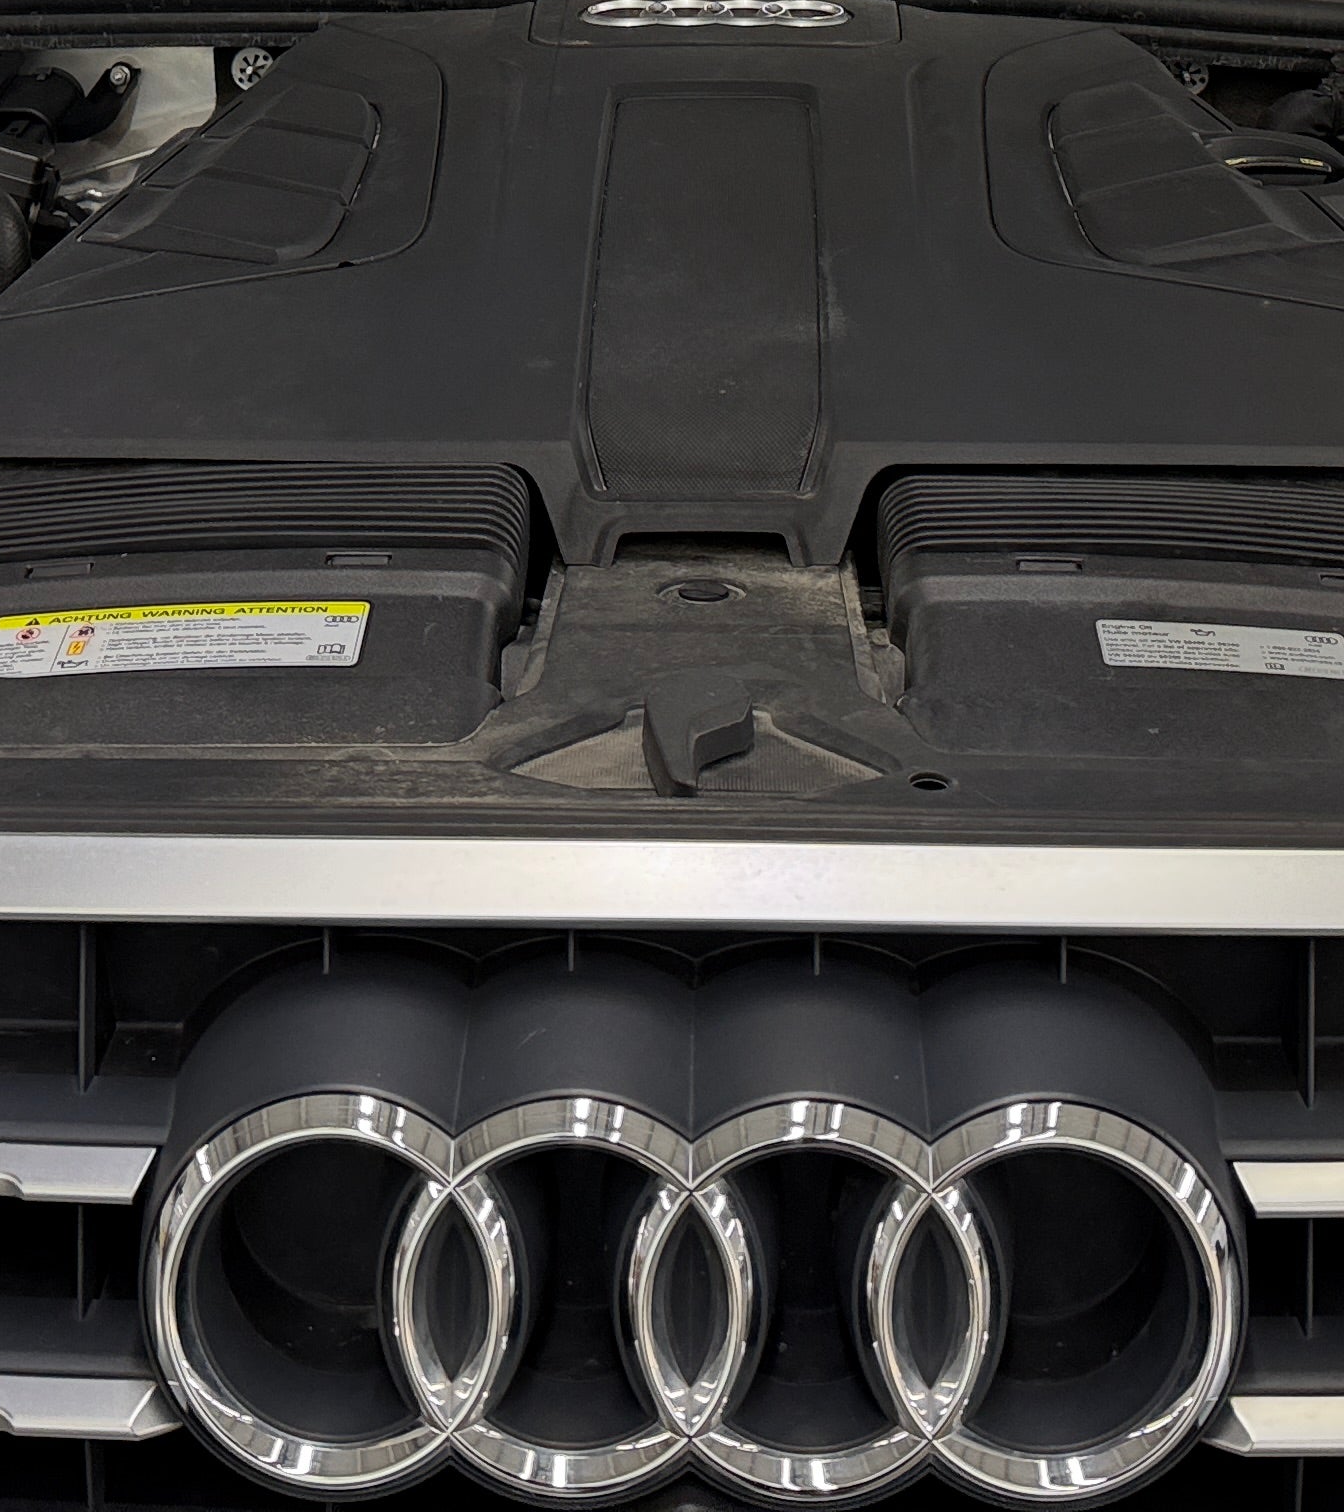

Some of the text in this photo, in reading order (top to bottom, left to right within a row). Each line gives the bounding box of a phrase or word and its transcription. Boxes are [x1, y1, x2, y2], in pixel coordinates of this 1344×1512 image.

[48, 605, 329, 625] ACHTUNG WARNING ATTENTION
